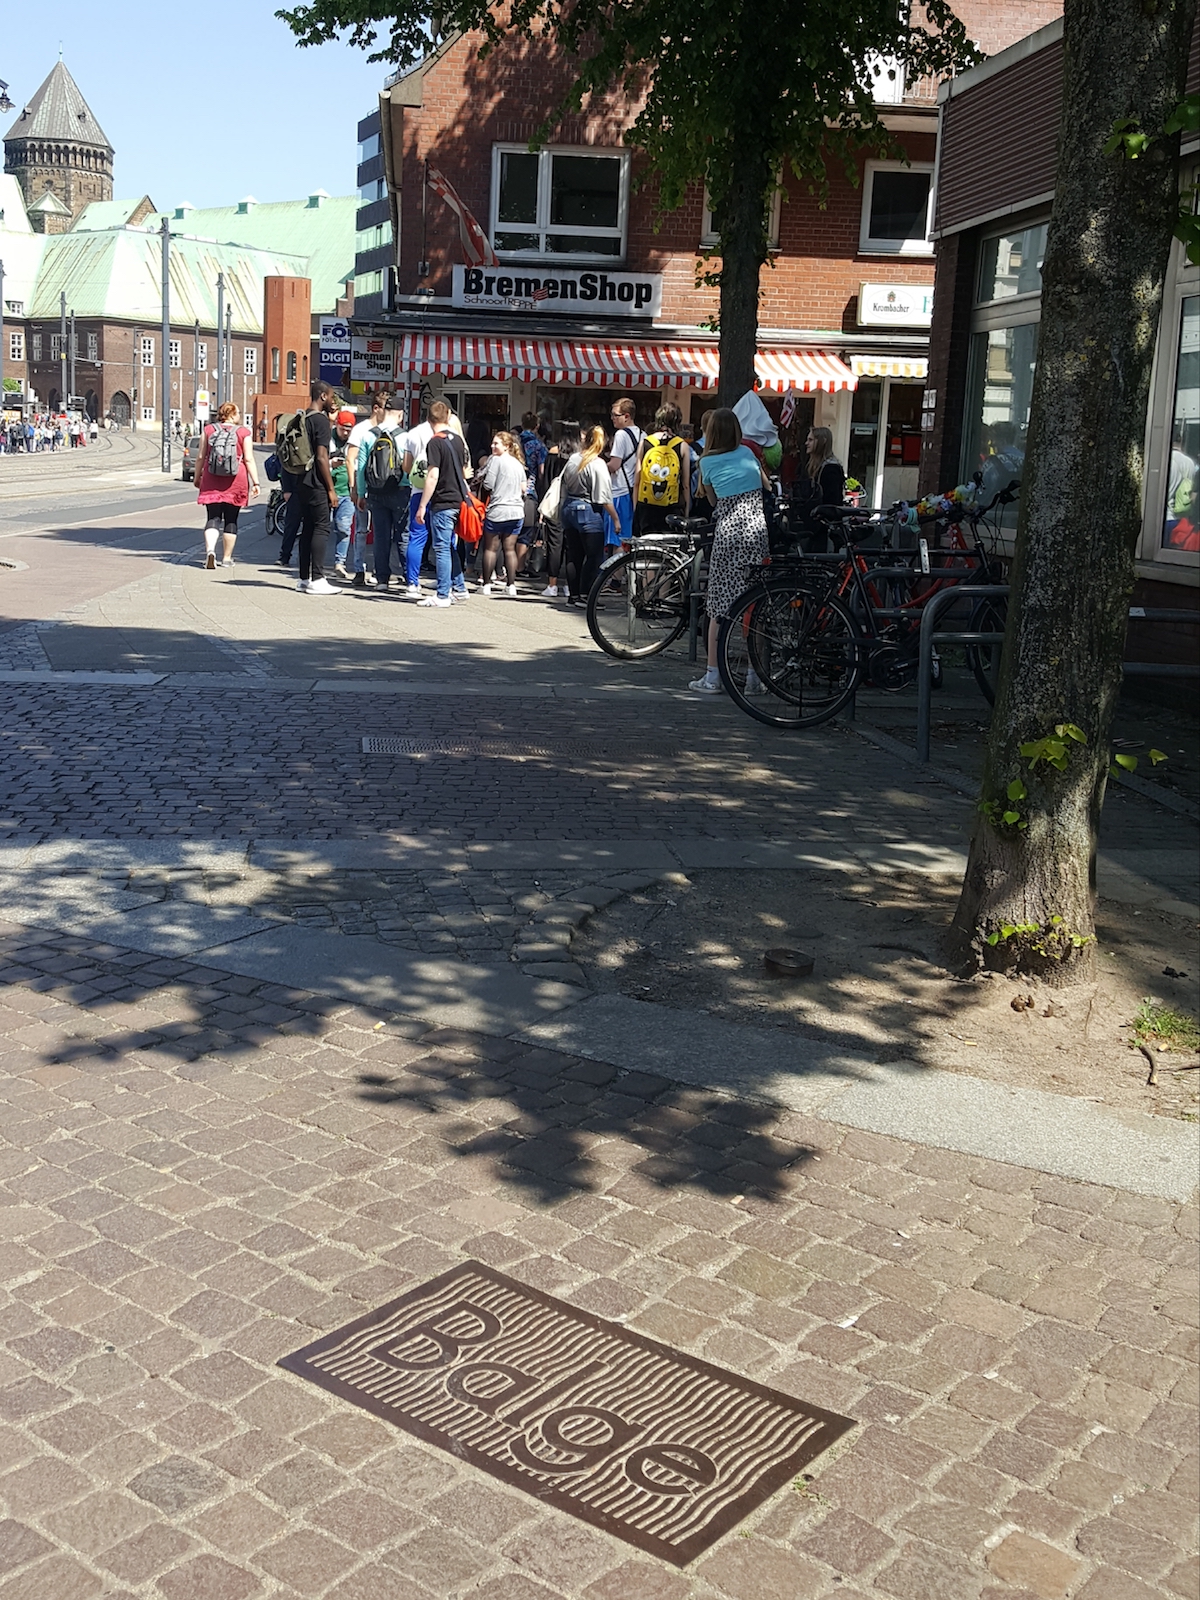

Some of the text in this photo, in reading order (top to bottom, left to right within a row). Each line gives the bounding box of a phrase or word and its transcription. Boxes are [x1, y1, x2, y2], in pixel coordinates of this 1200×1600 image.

[463, 268, 652, 308] BremenShop
[873, 303, 910, 313] Krombacher
[353, 351, 391, 361] Bremen
[366, 360, 391, 372] Shop
[363, 1300, 719, 1498] Balge
